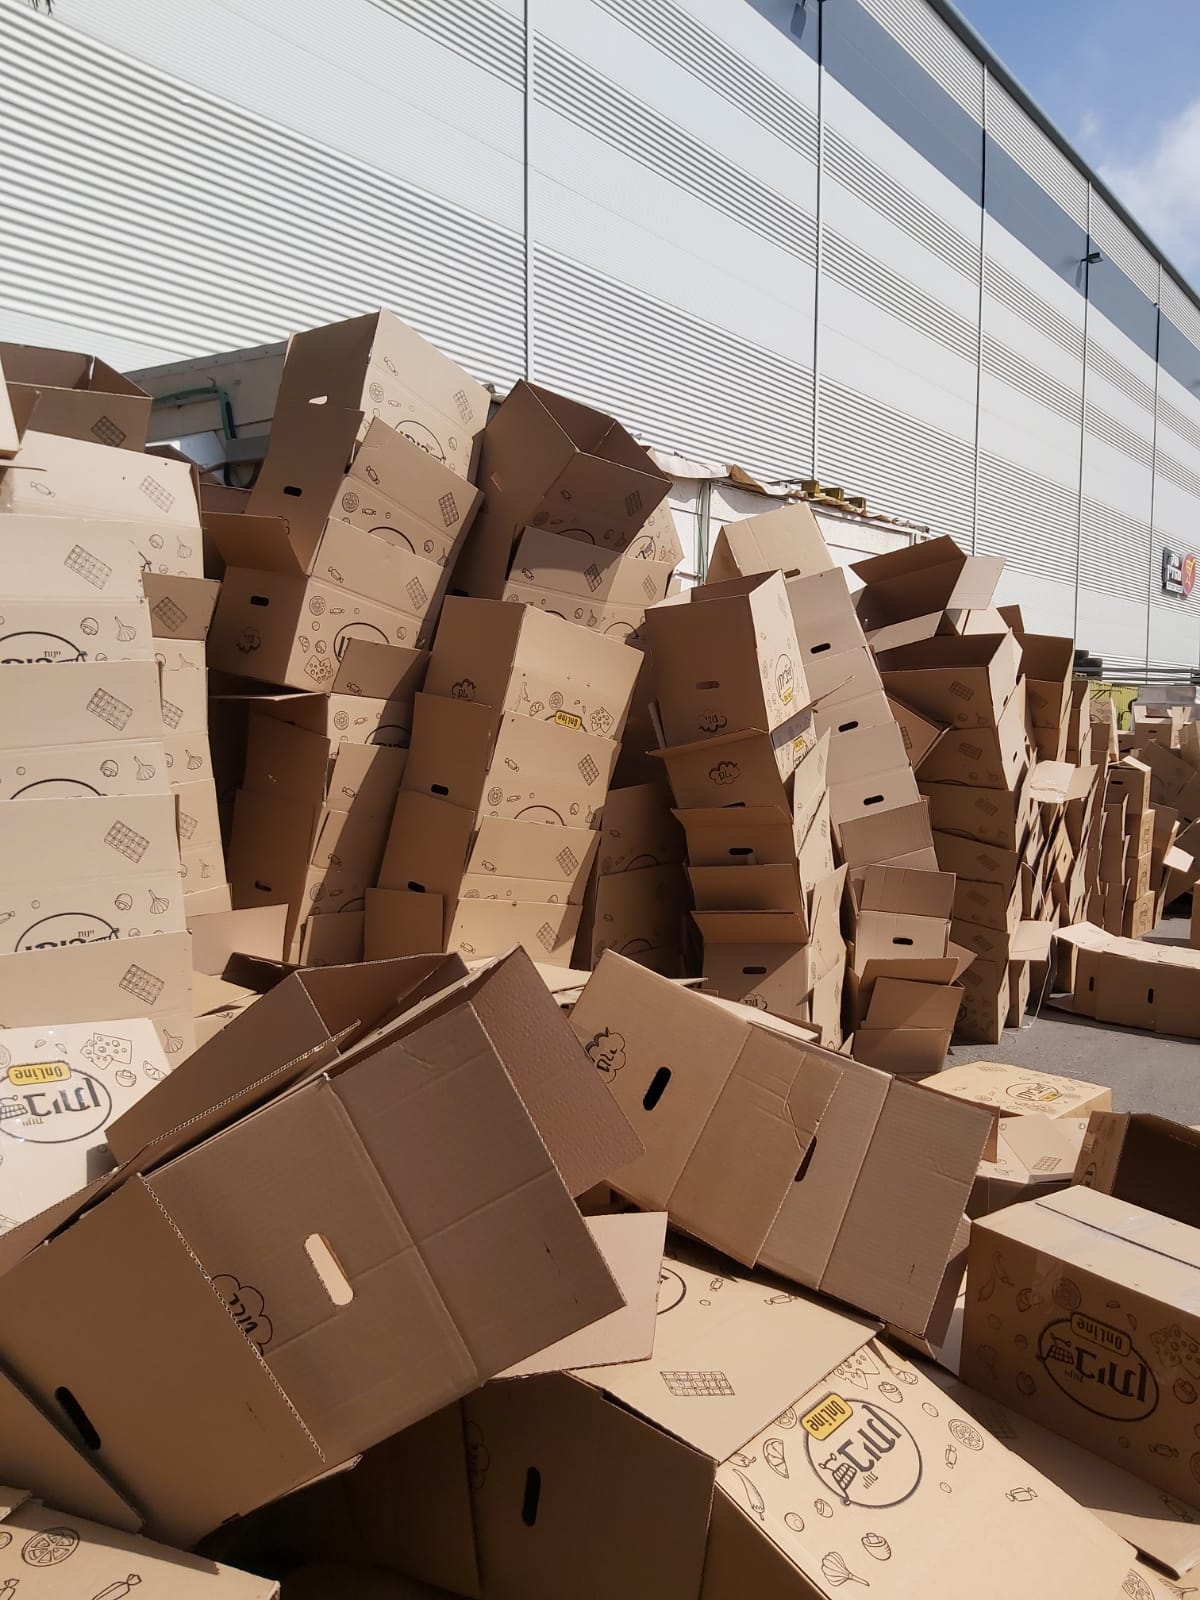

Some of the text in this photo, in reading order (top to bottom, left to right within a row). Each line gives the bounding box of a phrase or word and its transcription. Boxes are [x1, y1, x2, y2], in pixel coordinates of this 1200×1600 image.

[22, 1077, 101, 1118] ביתן
[1074, 1346, 1149, 1403] ביתן
[836, 1404, 902, 1474] ביתן
